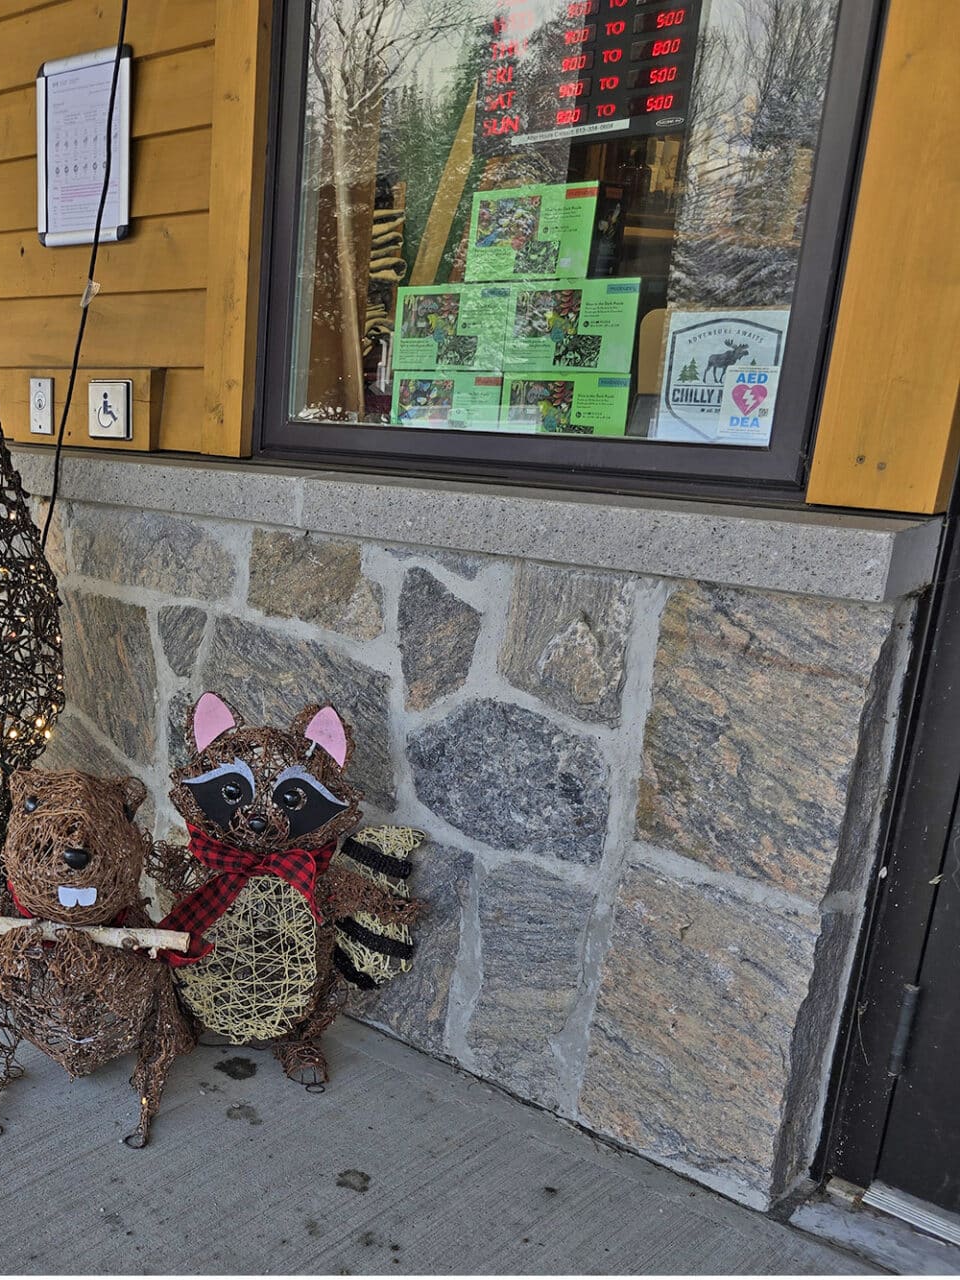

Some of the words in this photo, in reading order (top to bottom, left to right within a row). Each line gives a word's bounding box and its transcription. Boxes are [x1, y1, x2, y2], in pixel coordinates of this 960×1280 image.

[605, 21, 626, 36] TO
[602, 48, 622, 63] TO
[599, 76, 619, 91] TO
[596, 103, 616, 117] TO
[482, 114, 520, 137] SUN
[736, 373, 768, 384] AED
[672, 388, 714, 403] CHILLY
[729, 416, 760, 428] DEA
